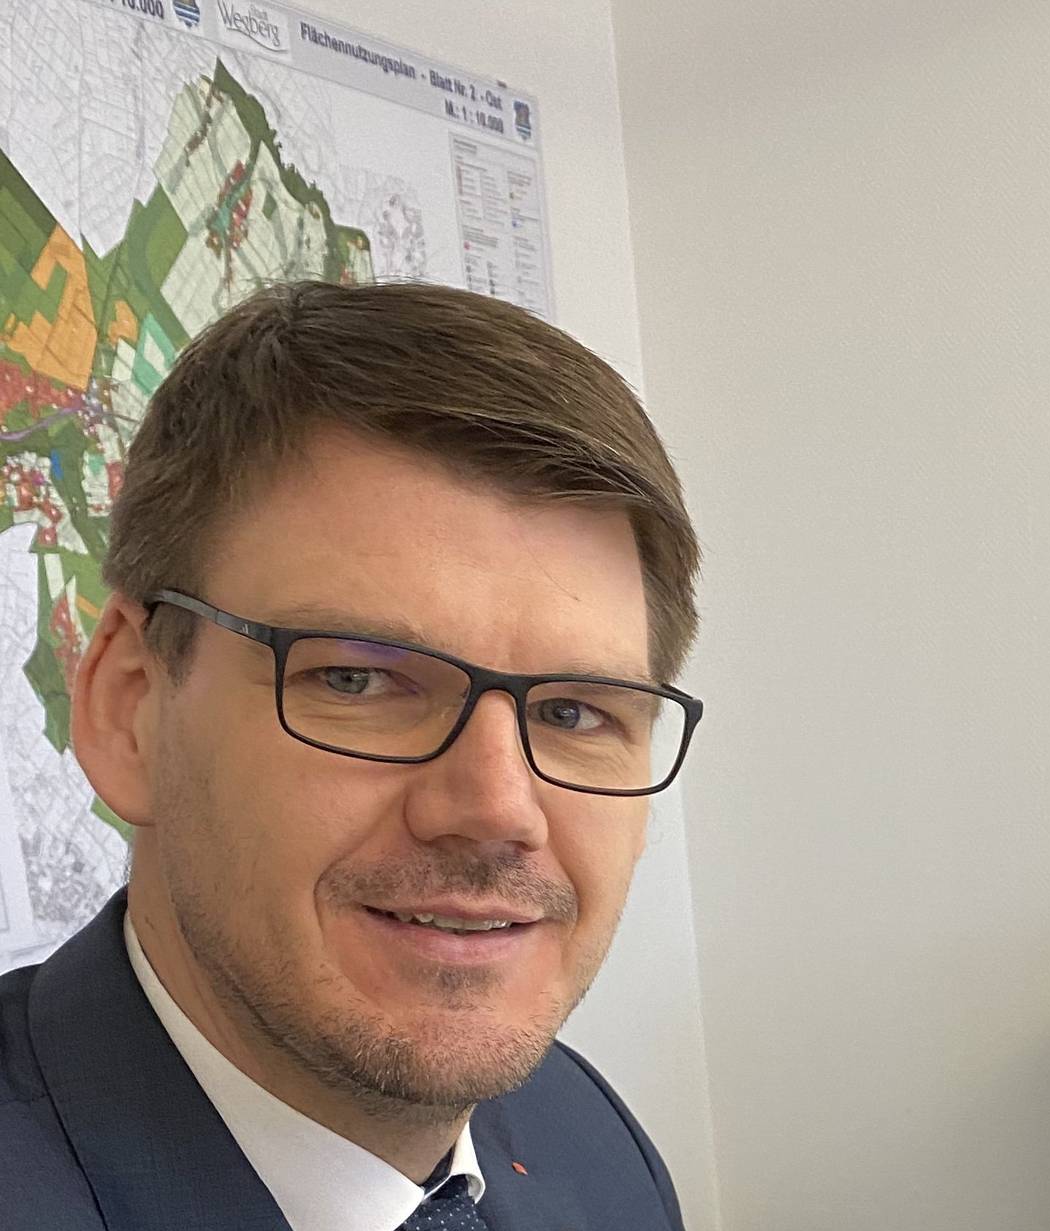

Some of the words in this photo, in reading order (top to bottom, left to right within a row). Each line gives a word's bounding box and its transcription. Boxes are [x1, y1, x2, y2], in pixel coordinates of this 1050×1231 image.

[299, 21, 417, 80] Flächennutzungsplan
[428, 68, 454, 93] Blatt
[453, 79, 469, 97] Nr.
[469, 83, 476, 101] 2
